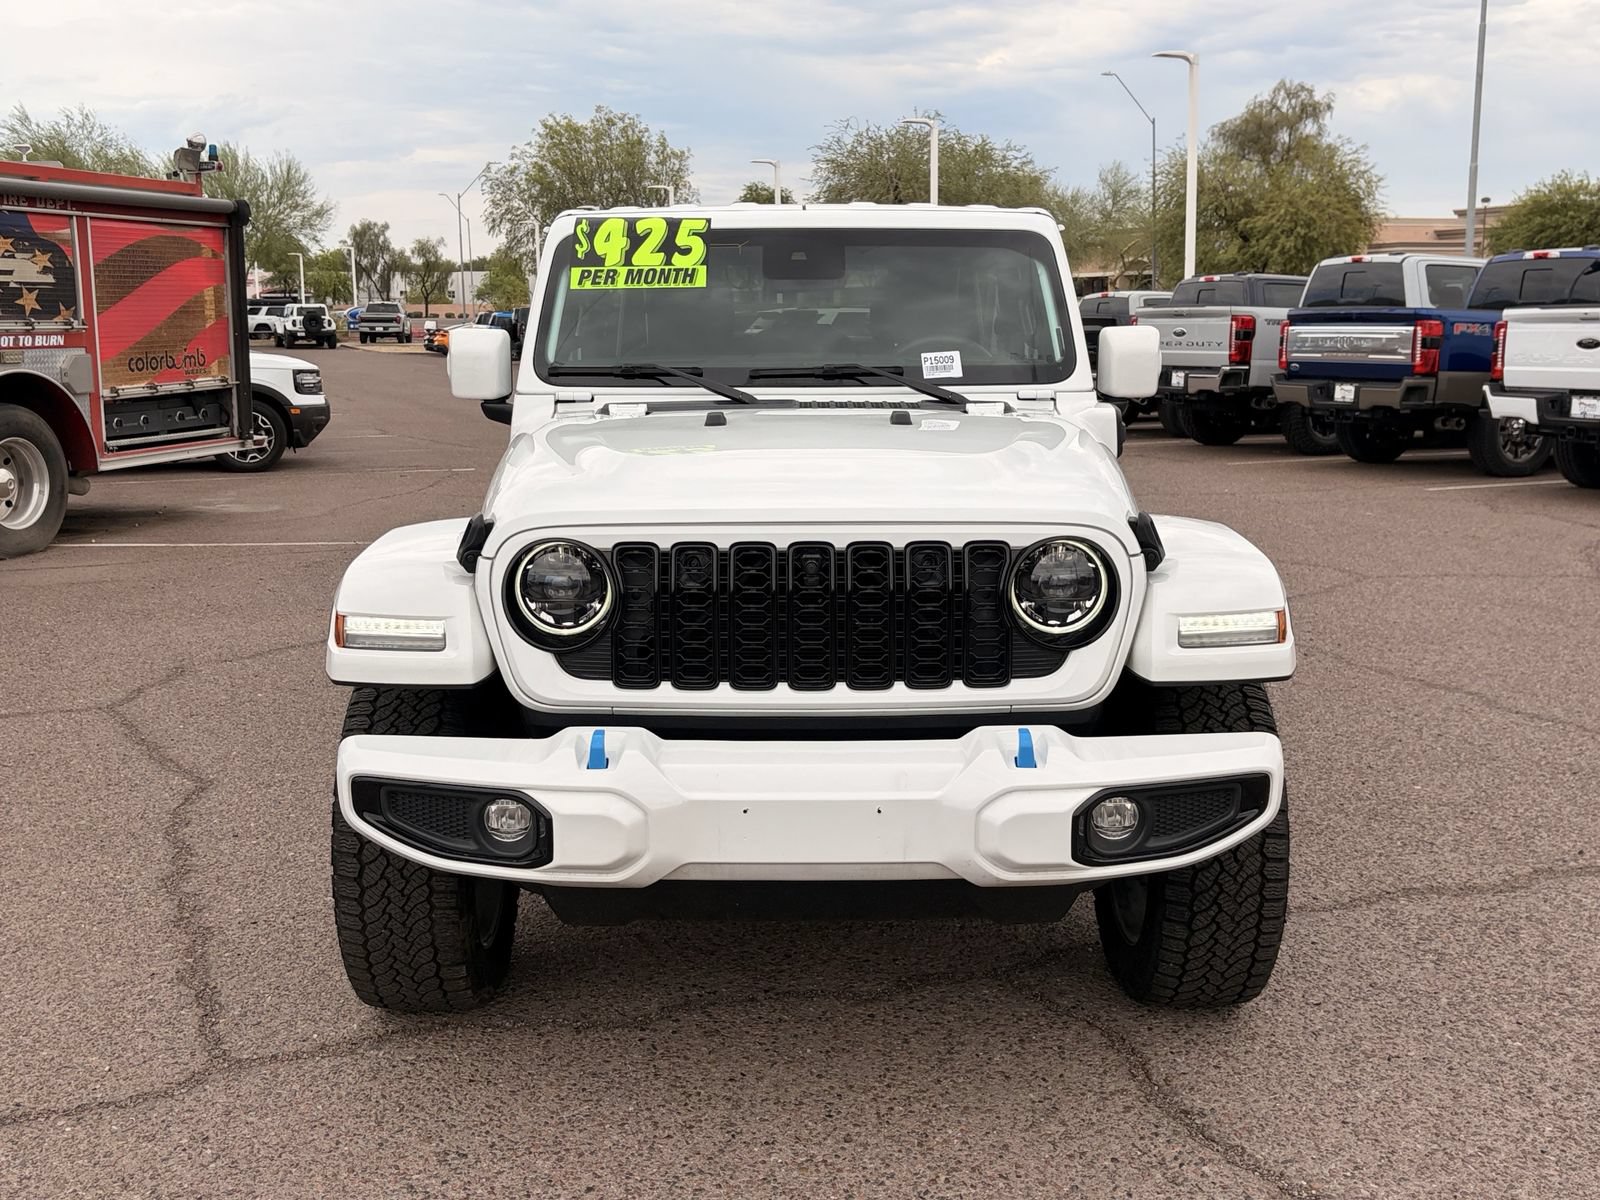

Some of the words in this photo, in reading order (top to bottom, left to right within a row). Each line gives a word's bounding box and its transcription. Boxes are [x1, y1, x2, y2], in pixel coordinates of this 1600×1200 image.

[575, 217, 708, 267] $425
[578, 268, 619, 287] PER
[624, 267, 698, 287] MONTH
[1453, 322, 1491, 336] FX4
[18, 335, 33, 347] TO
[35, 334, 65, 346] BURN
[923, 355, 955, 366] P15009
